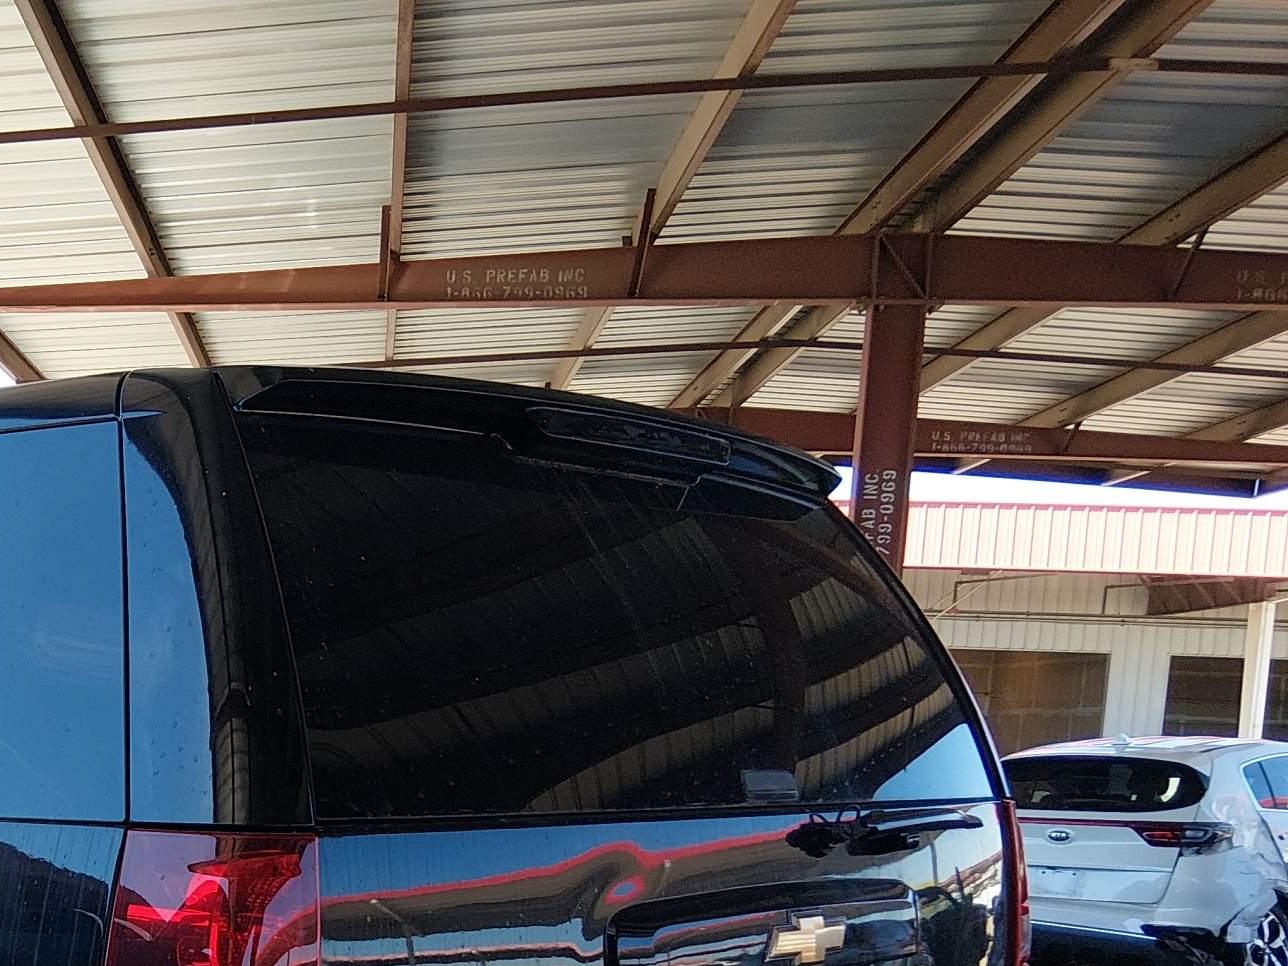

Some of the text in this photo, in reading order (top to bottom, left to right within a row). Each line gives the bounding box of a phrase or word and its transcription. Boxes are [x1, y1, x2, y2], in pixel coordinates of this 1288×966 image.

[486, 268, 550, 284] PREFAB
[558, 267, 585, 283] INC
[446, 285, 588, 299] 1-866-799-0969
[960, 431, 1006, 442] PREFAB
[863, 473, 879, 500] INC
[876, 470, 897, 555] 799-0969
